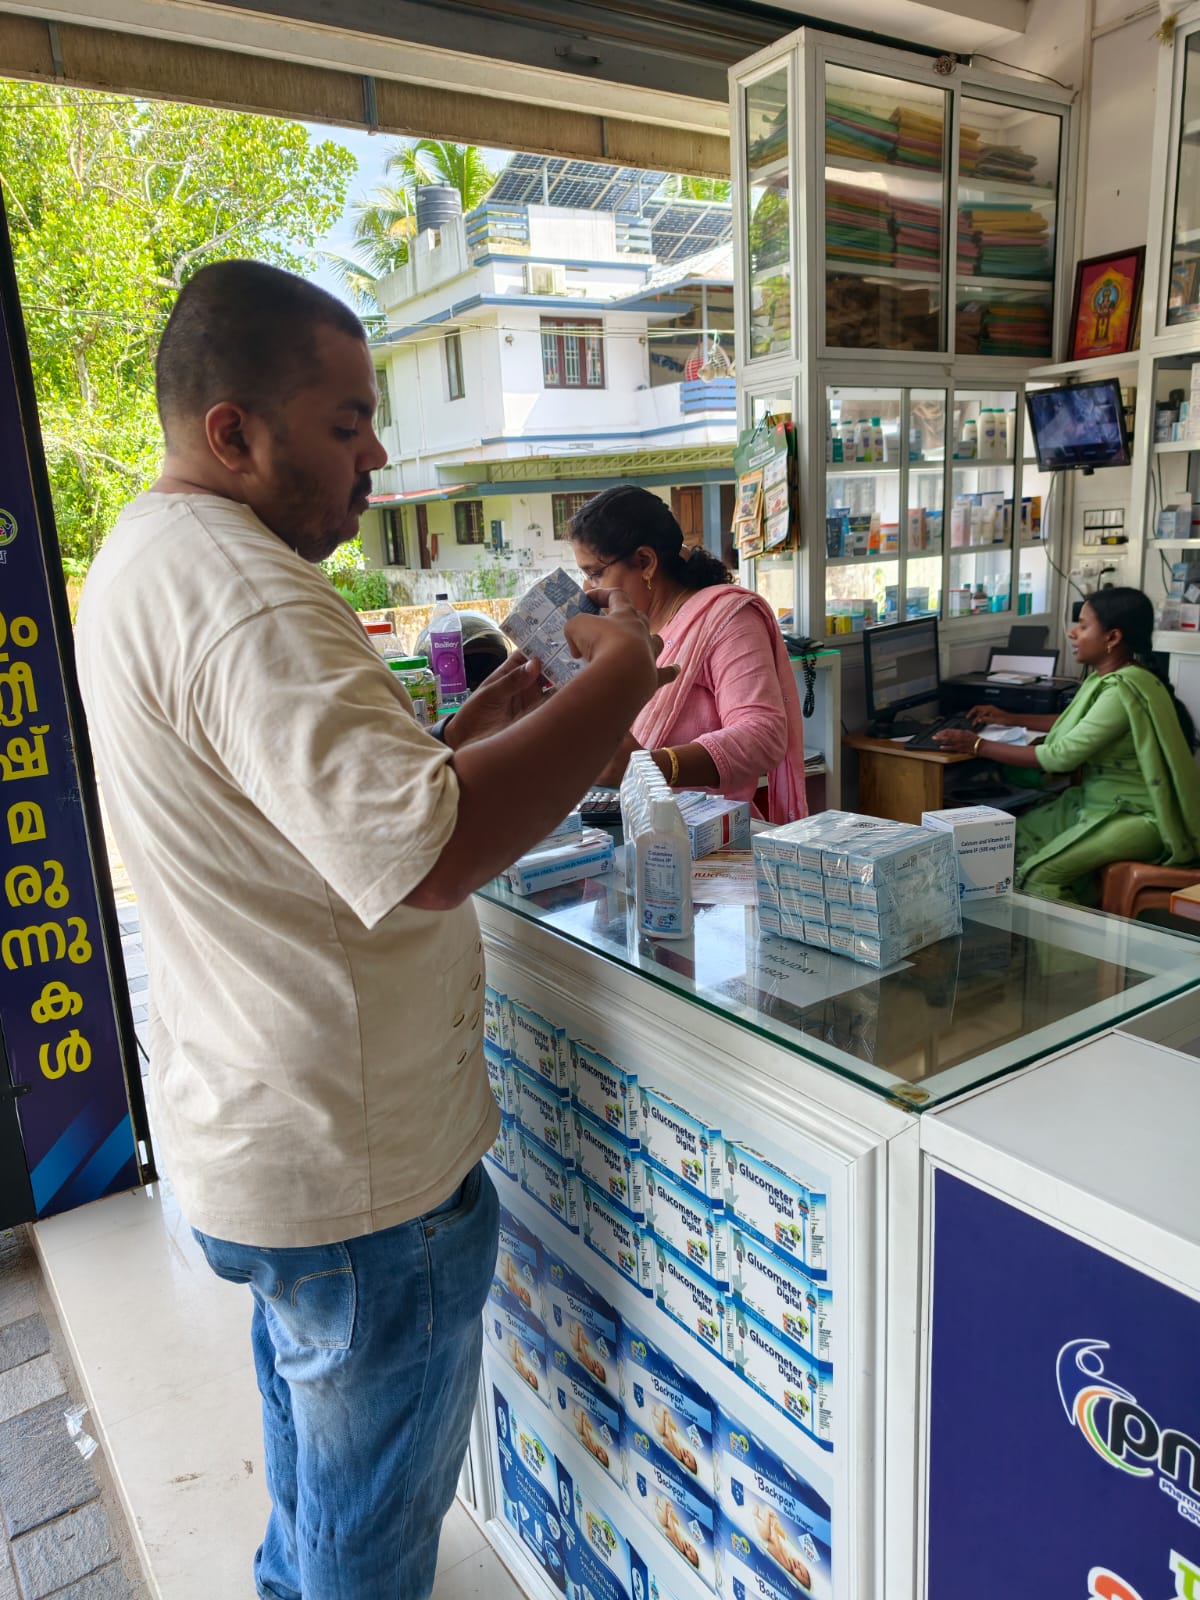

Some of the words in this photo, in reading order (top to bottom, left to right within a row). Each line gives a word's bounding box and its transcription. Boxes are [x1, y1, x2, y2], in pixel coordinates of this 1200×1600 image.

[1, 800, 94, 1080] മരുന്നുകൾ
[764, 954, 820, 975] HOLIDAY
[580, 1058, 617, 1089] Glucometer
[600, 1081, 618, 1099] Digital
[651, 1106, 696, 1143] Glucometer
[584, 1130, 621, 1161] Glucometer
[675, 1134, 697, 1155] Digital
[739, 1162, 794, 1204] Glucometer
[592, 1202, 630, 1238] Glucometer
[657, 1185, 702, 1224] Glucometer
[768, 1194, 794, 1219] Digital
[681, 1215, 703, 1237] Digital
[667, 1263, 713, 1304] Glucometer
[747, 1252, 802, 1298] Glucometer
[692, 1293, 713, 1317] Digital
[776, 1285, 802, 1311] Digital
[749, 1330, 803, 1377] Glucometer
[778, 1363, 803, 1390] Digital
[754, 1472, 796, 1511] Bachpan
[1161, 1480, 1200, 1511] Pharm
[783, 1505, 796, 1520] Baby
